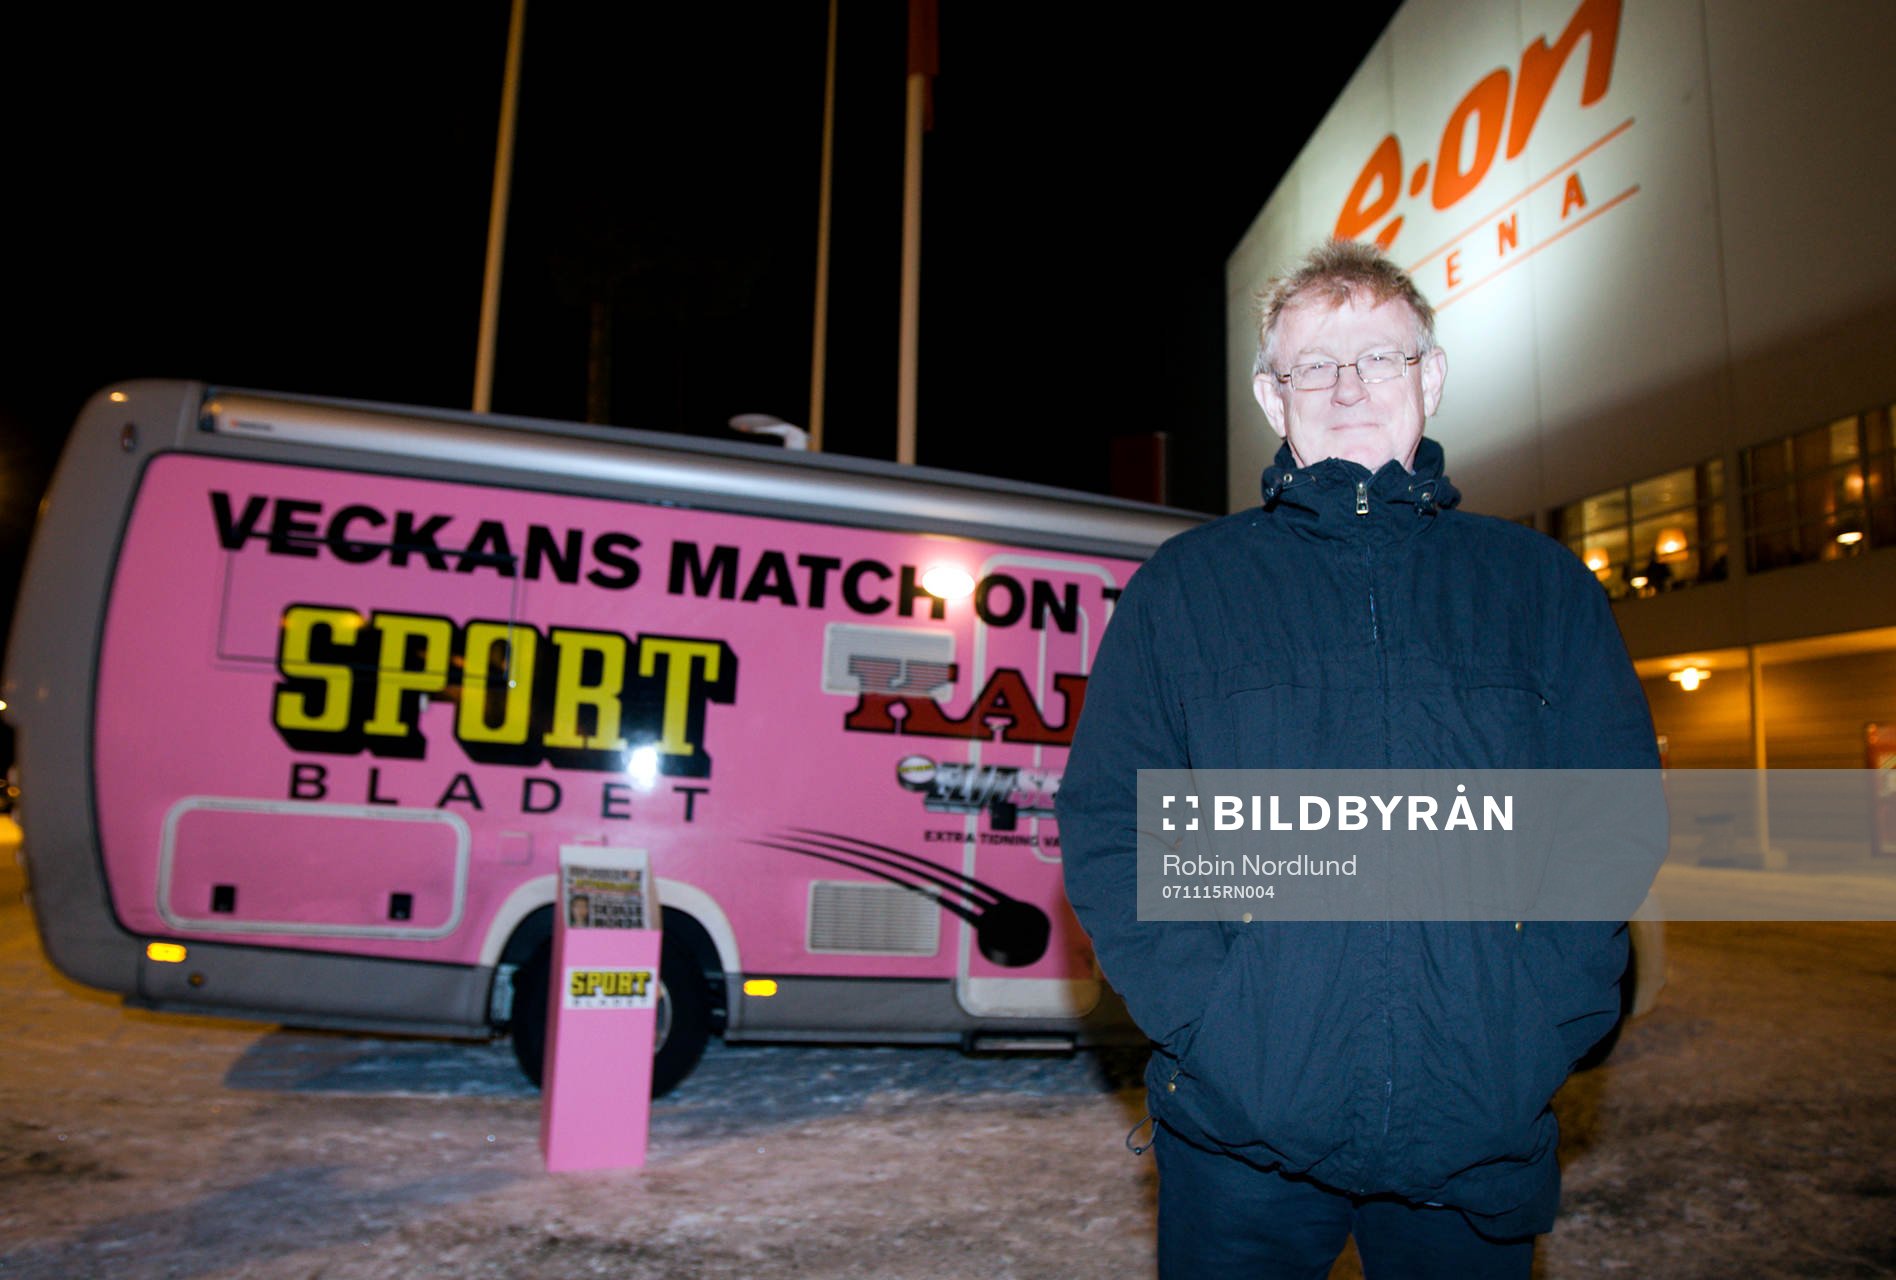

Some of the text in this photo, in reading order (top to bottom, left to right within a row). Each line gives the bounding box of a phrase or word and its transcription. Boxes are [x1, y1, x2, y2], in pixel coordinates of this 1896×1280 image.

[1445, 171, 1588, 289] ENA
[208, 490, 1080, 634] VECKANS MATCH ON
[273, 602, 732, 770] SPORT
[289, 763, 711, 823] BLADET
[924, 830, 976, 844] EXTRA
[571, 971, 651, 997] SPORT
